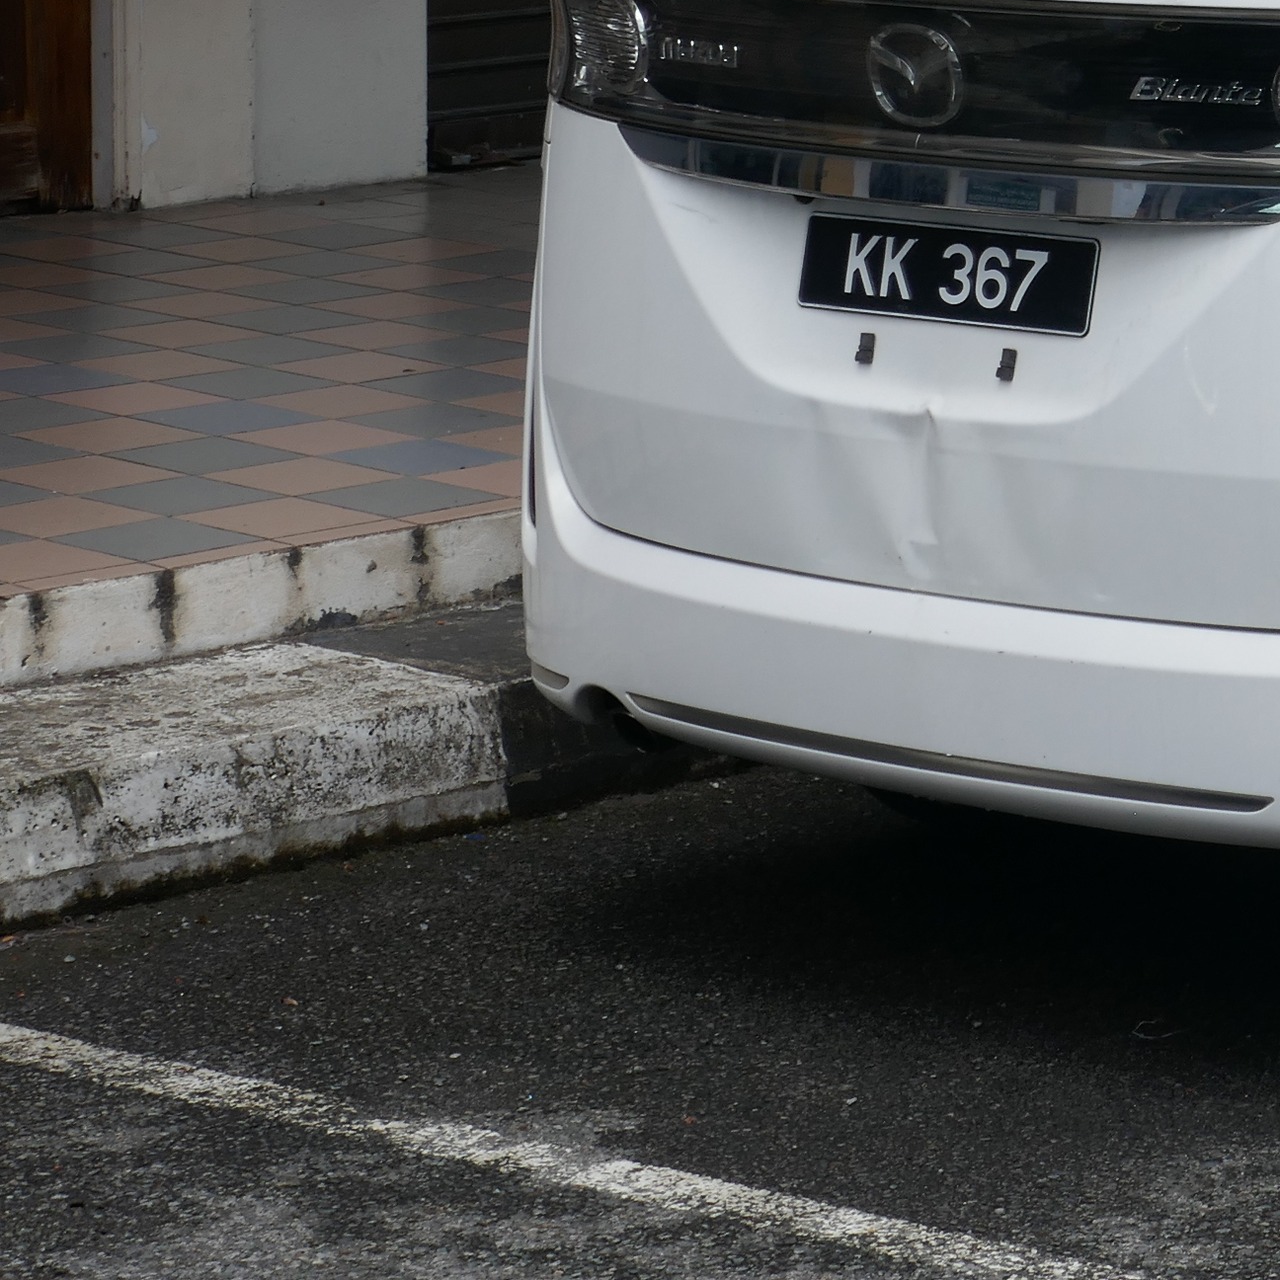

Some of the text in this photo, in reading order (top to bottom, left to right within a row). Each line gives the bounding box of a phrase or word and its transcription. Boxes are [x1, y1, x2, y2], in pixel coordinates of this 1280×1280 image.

[1129, 76, 1263, 106] Biante
[844, 232, 1050, 312] KK 367
